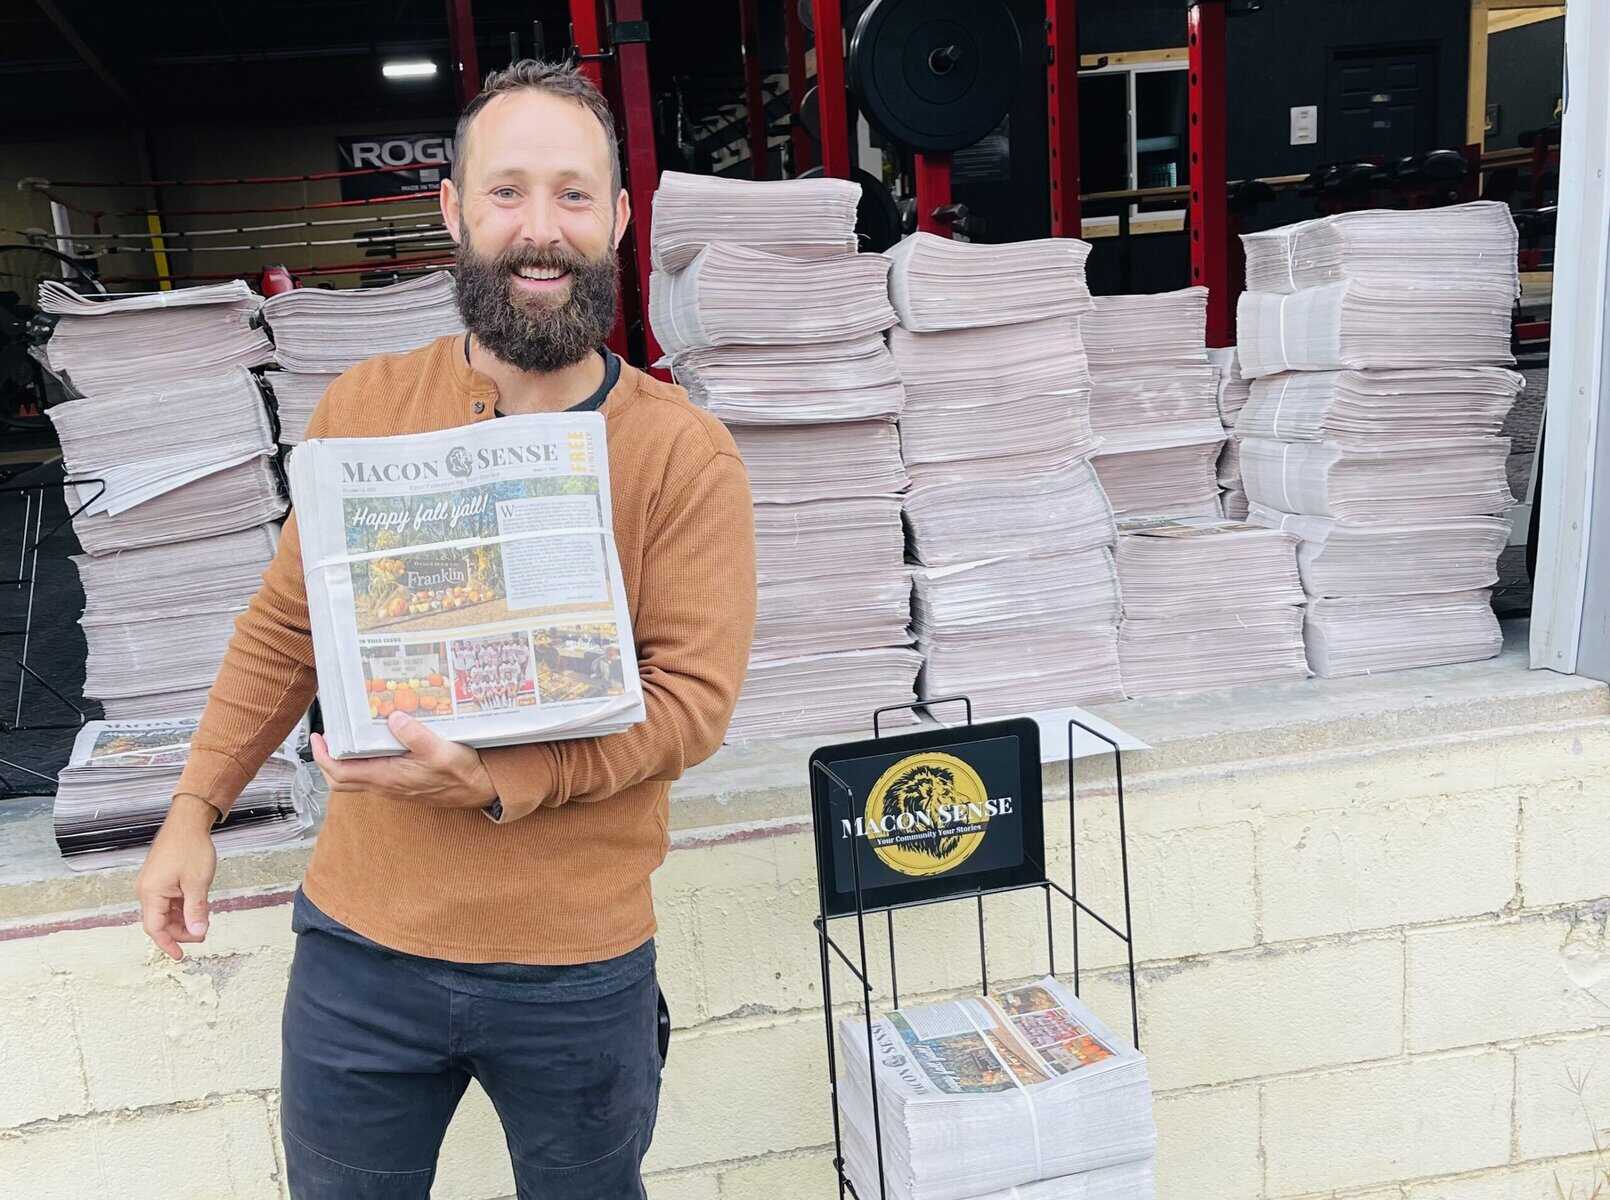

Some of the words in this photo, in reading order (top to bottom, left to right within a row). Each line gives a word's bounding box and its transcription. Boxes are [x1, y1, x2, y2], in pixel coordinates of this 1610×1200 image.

[341, 460, 439, 483] MACON
[476, 443, 558, 470] SENSE
[352, 506, 411, 532] Happy
[413, 500, 449, 531] fall
[407, 567, 465, 588] Franklin
[841, 809, 932, 838] MACON
[937, 797, 1013, 824] SENSE
[877, 838, 895, 846] Your
[895, 831, 937, 844] Community
[937, 827, 955, 838] Your
[956, 824, 982, 834] Stories
